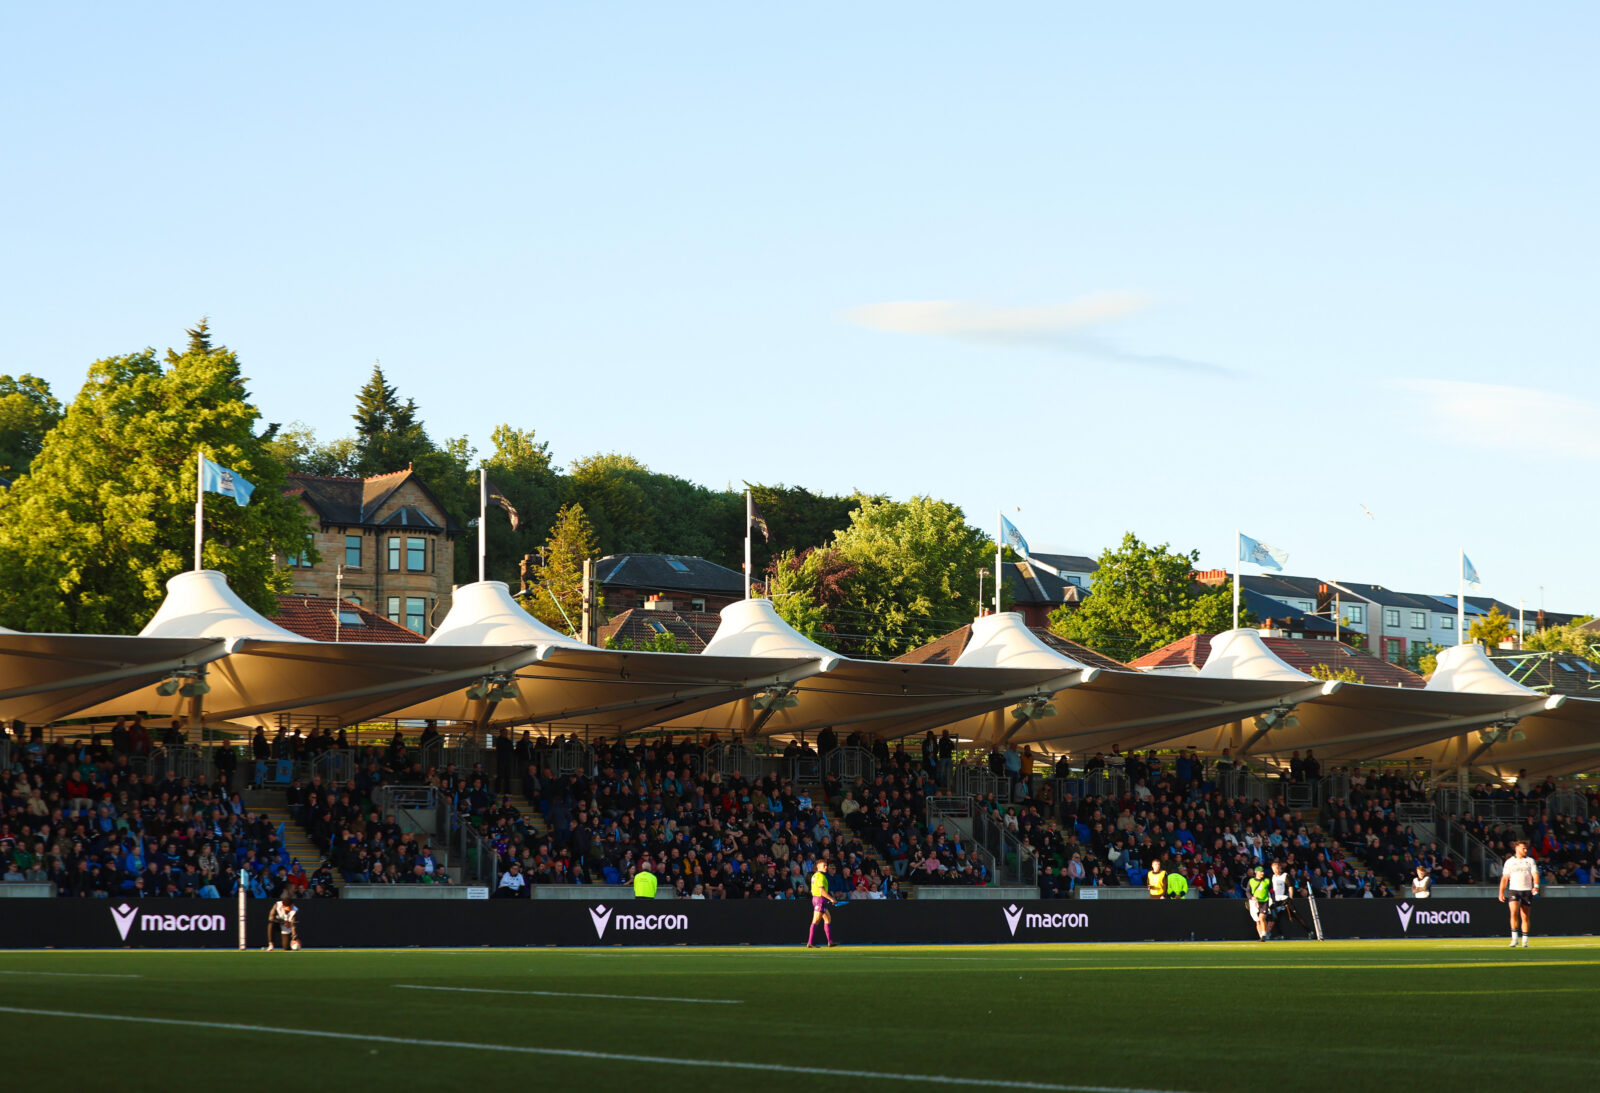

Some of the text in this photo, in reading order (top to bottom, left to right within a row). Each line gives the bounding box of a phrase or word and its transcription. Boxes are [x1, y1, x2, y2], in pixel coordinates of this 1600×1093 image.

[141, 914, 226, 931] macron
[616, 914, 688, 930] macron
[1025, 912, 1089, 928] macron
[1416, 910, 1470, 924] macron
